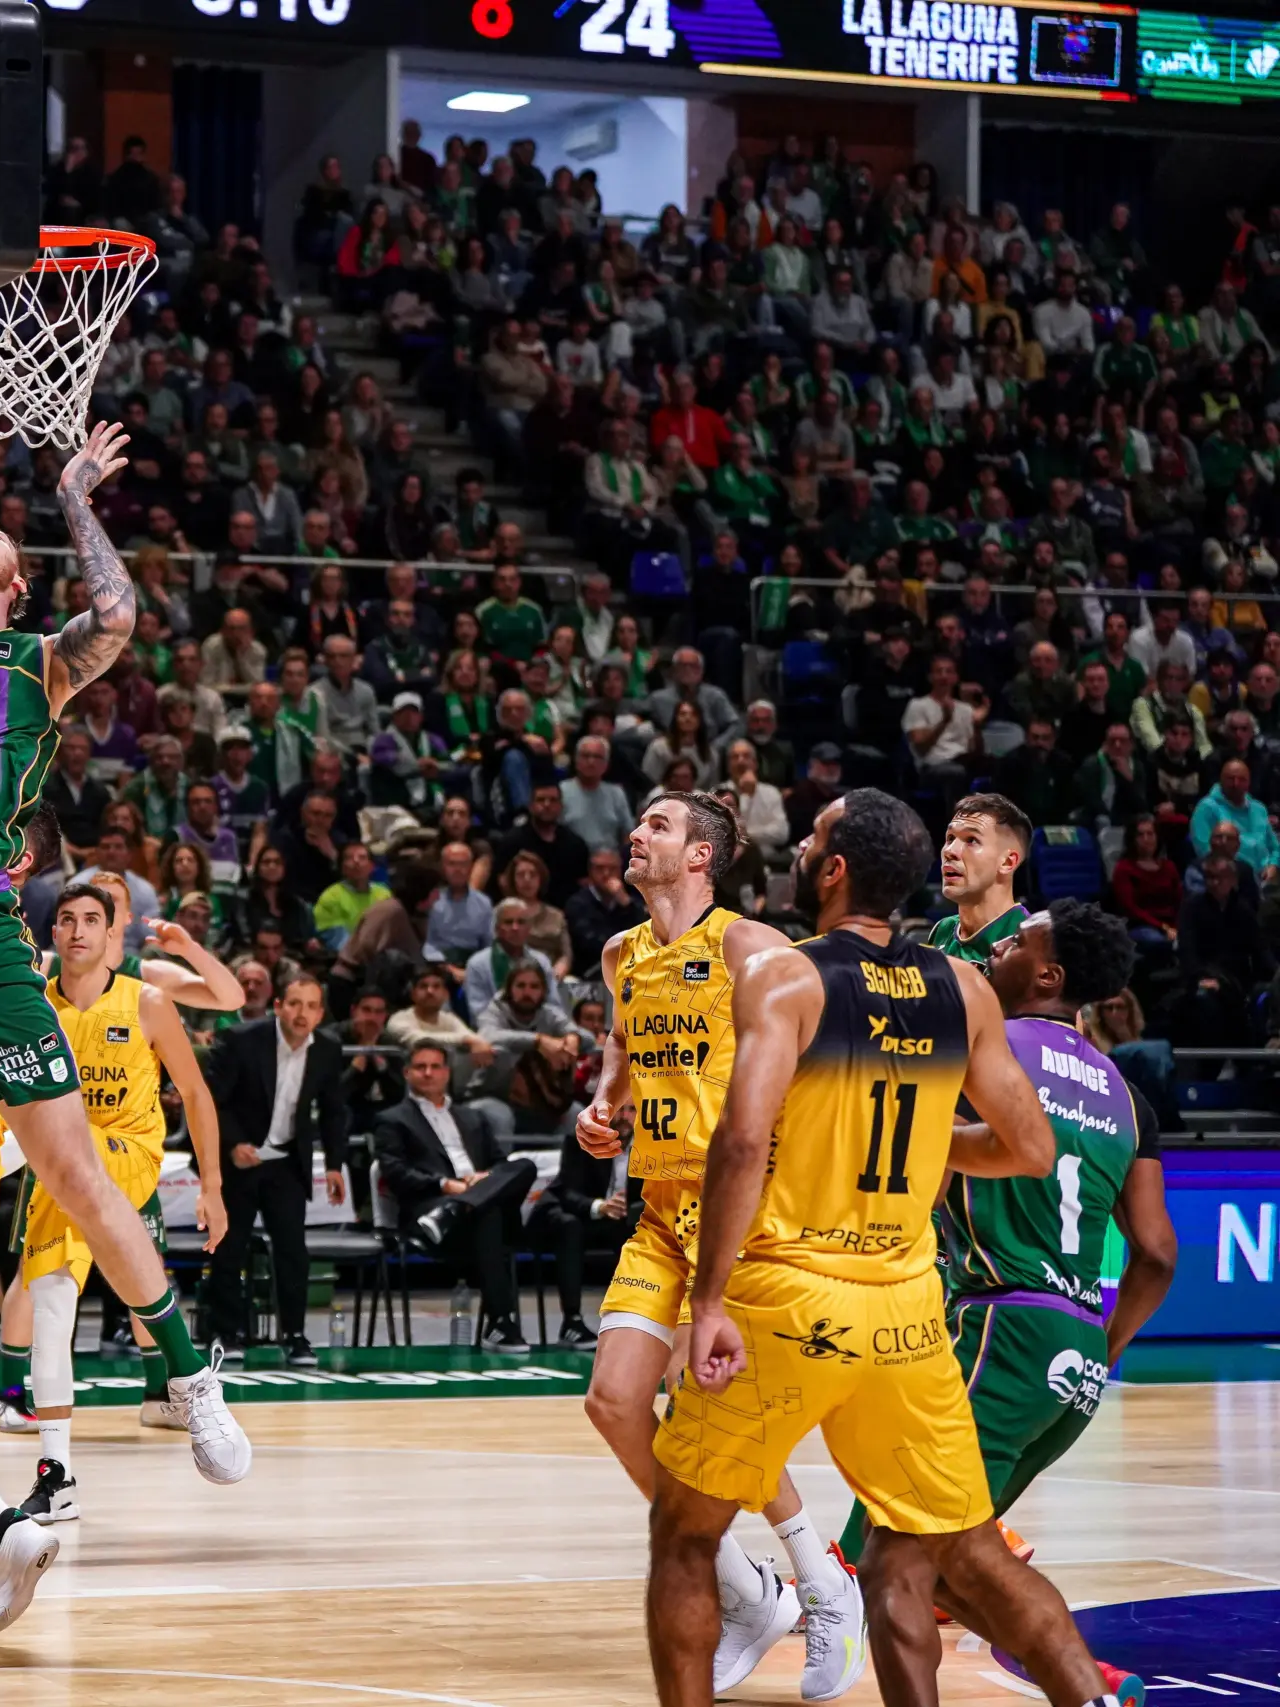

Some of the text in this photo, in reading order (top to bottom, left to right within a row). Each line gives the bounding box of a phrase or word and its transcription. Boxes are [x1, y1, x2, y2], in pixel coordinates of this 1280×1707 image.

[580, 0, 676, 58] 24
[842, 0, 1019, 46] LA LAGUNA
[864, 35, 1019, 84] TENERIFE
[633, 1014, 709, 1037] LAGUNA
[80, 1065, 128, 1082] GUNA
[629, 1041, 710, 1076] nerife!
[641, 1097, 678, 1142] 42
[857, 1079, 919, 1195] 11
[1056, 1153, 1083, 1255] 1
[613, 1275, 661, 1293] Hospiten
[873, 1318, 943, 1355] CICAR
